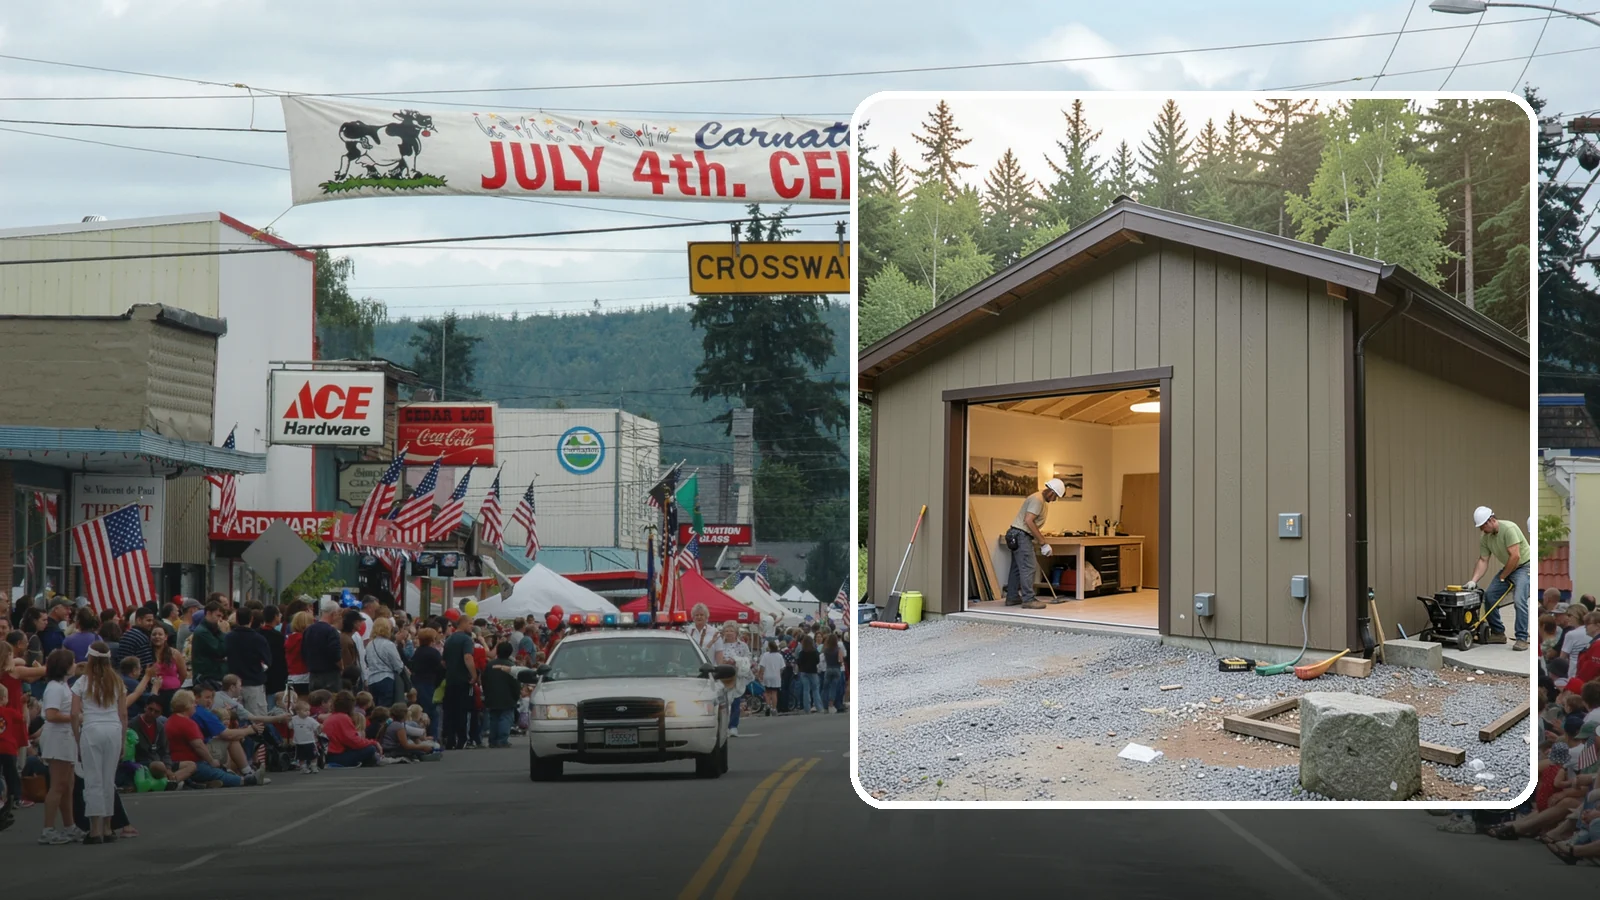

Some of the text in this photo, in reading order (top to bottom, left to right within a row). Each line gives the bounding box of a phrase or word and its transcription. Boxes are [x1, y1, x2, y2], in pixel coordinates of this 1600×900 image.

[481, 141, 605, 193] JULY
[632, 150, 746, 198] 4th.
[696, 254, 850, 280] CROSSWA
[282, 380, 373, 420] ACE
[406, 409, 452, 422] CEDAR
[283, 421, 371, 436] Hardware
[416, 428, 477, 447] Coca-Cola
[353, 467, 385, 481] Simpl
[95, 485, 124, 495] Vincent
[126, 485, 136, 495] de
[137, 485, 155, 495] Paul
[81, 503, 154, 522] THT
[688, 526, 741, 535] CRNATION
[699, 535, 730, 543] GLASS
